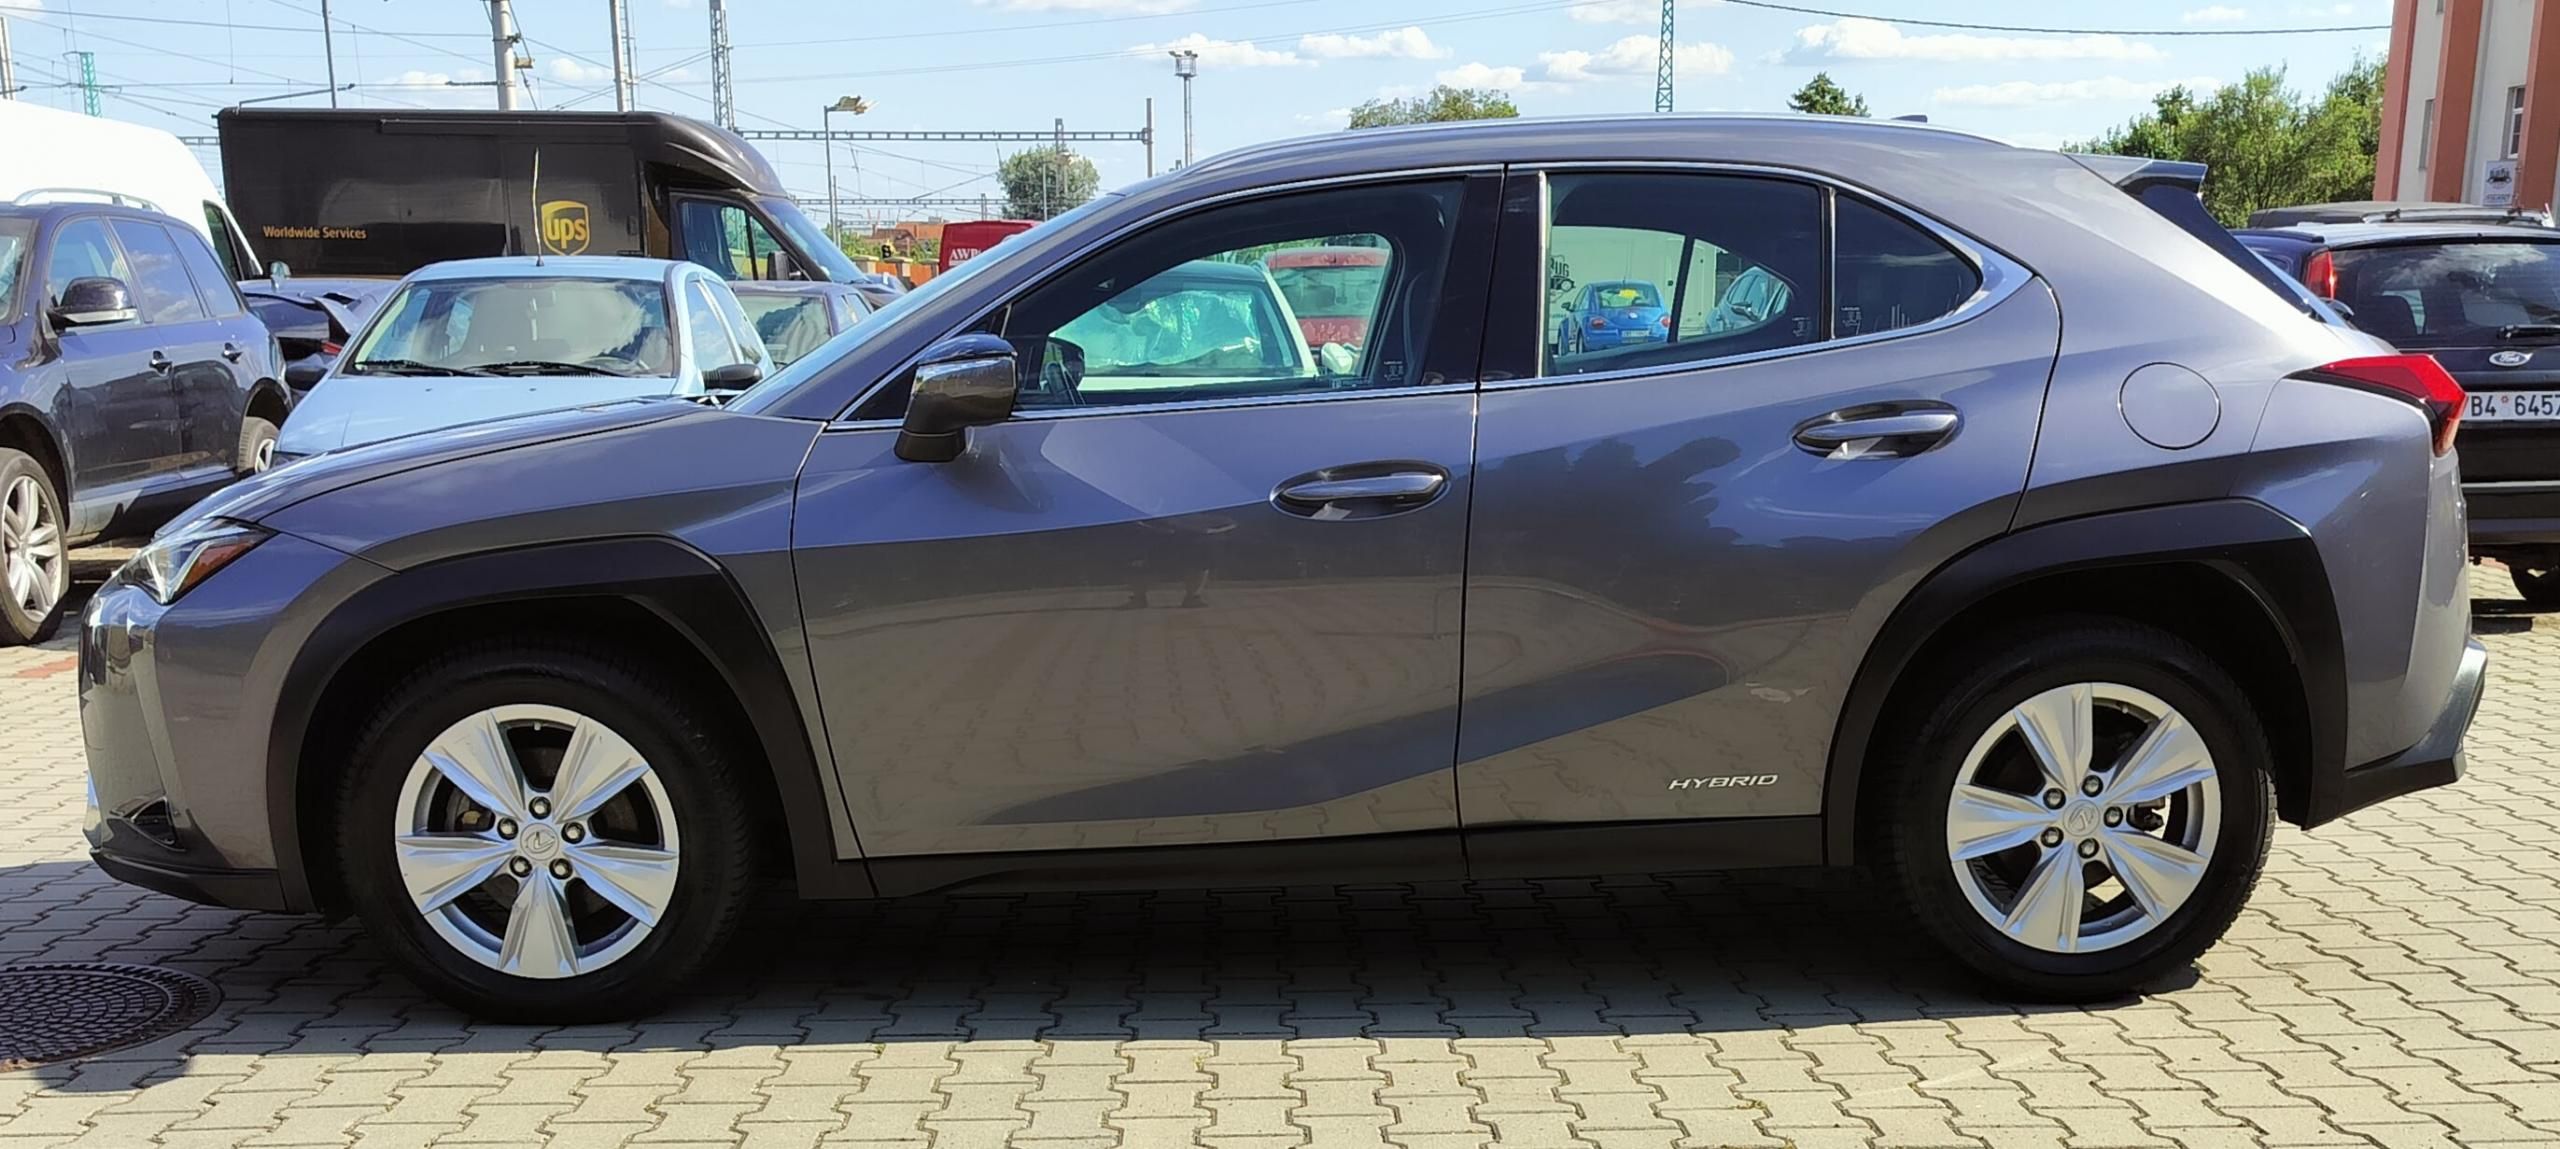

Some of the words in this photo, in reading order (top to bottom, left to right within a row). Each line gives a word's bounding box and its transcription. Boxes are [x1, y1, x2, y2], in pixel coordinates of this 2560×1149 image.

[263, 225, 320, 238] Worldwide
[322, 226, 367, 239] Services
[546, 218, 586, 249] ups
[1668, 774, 1778, 790] HYBRID
